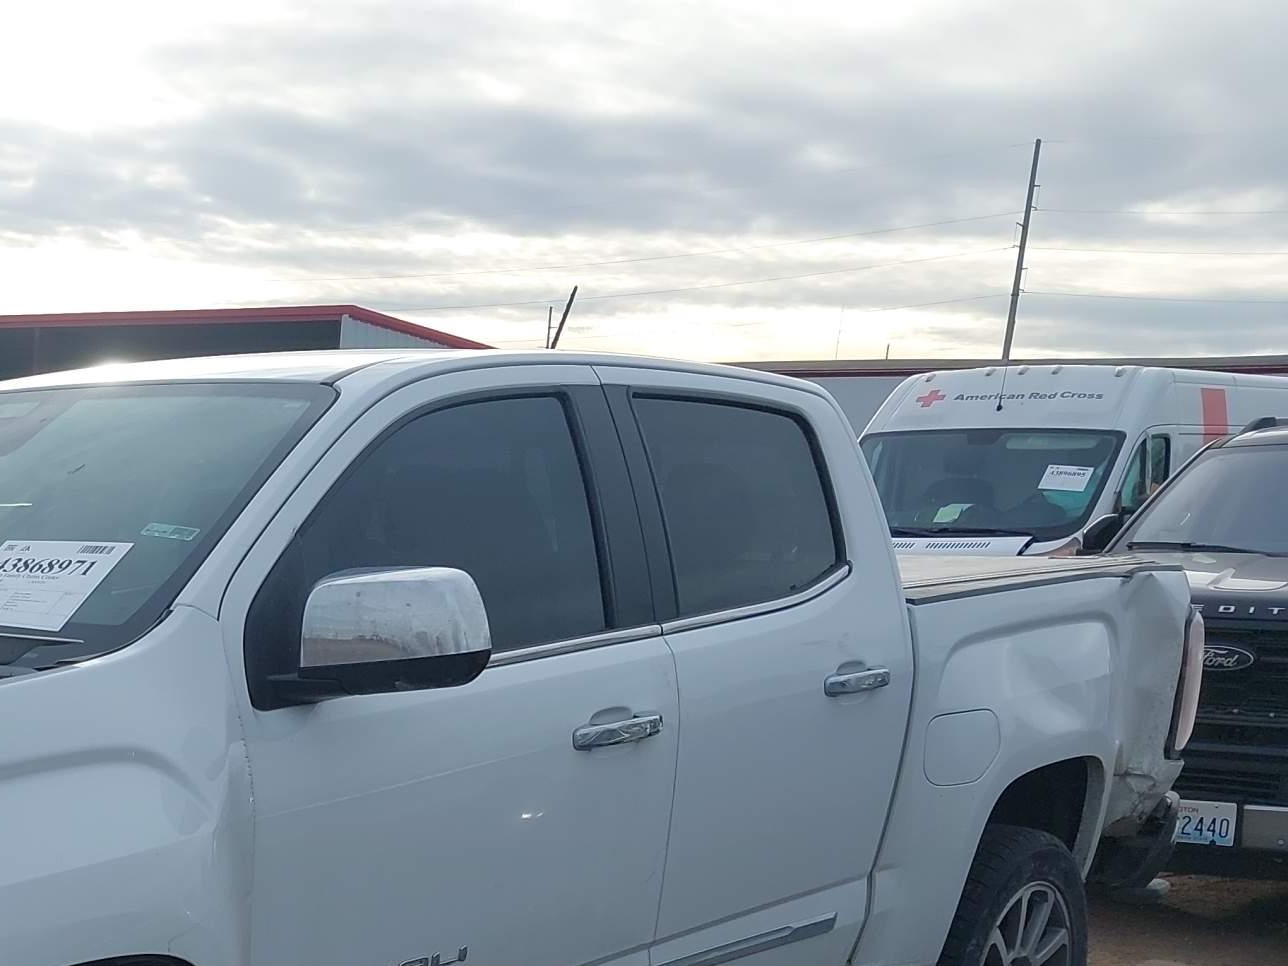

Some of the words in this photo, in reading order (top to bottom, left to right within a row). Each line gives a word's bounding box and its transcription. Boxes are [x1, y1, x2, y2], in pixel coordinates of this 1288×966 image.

[954, 393, 1025, 401] American
[1027, 392, 1059, 400] Red
[1059, 391, 1104, 400] Cross
[1203, 648, 1240, 667] Ford
[1181, 815, 1230, 838] 2440
